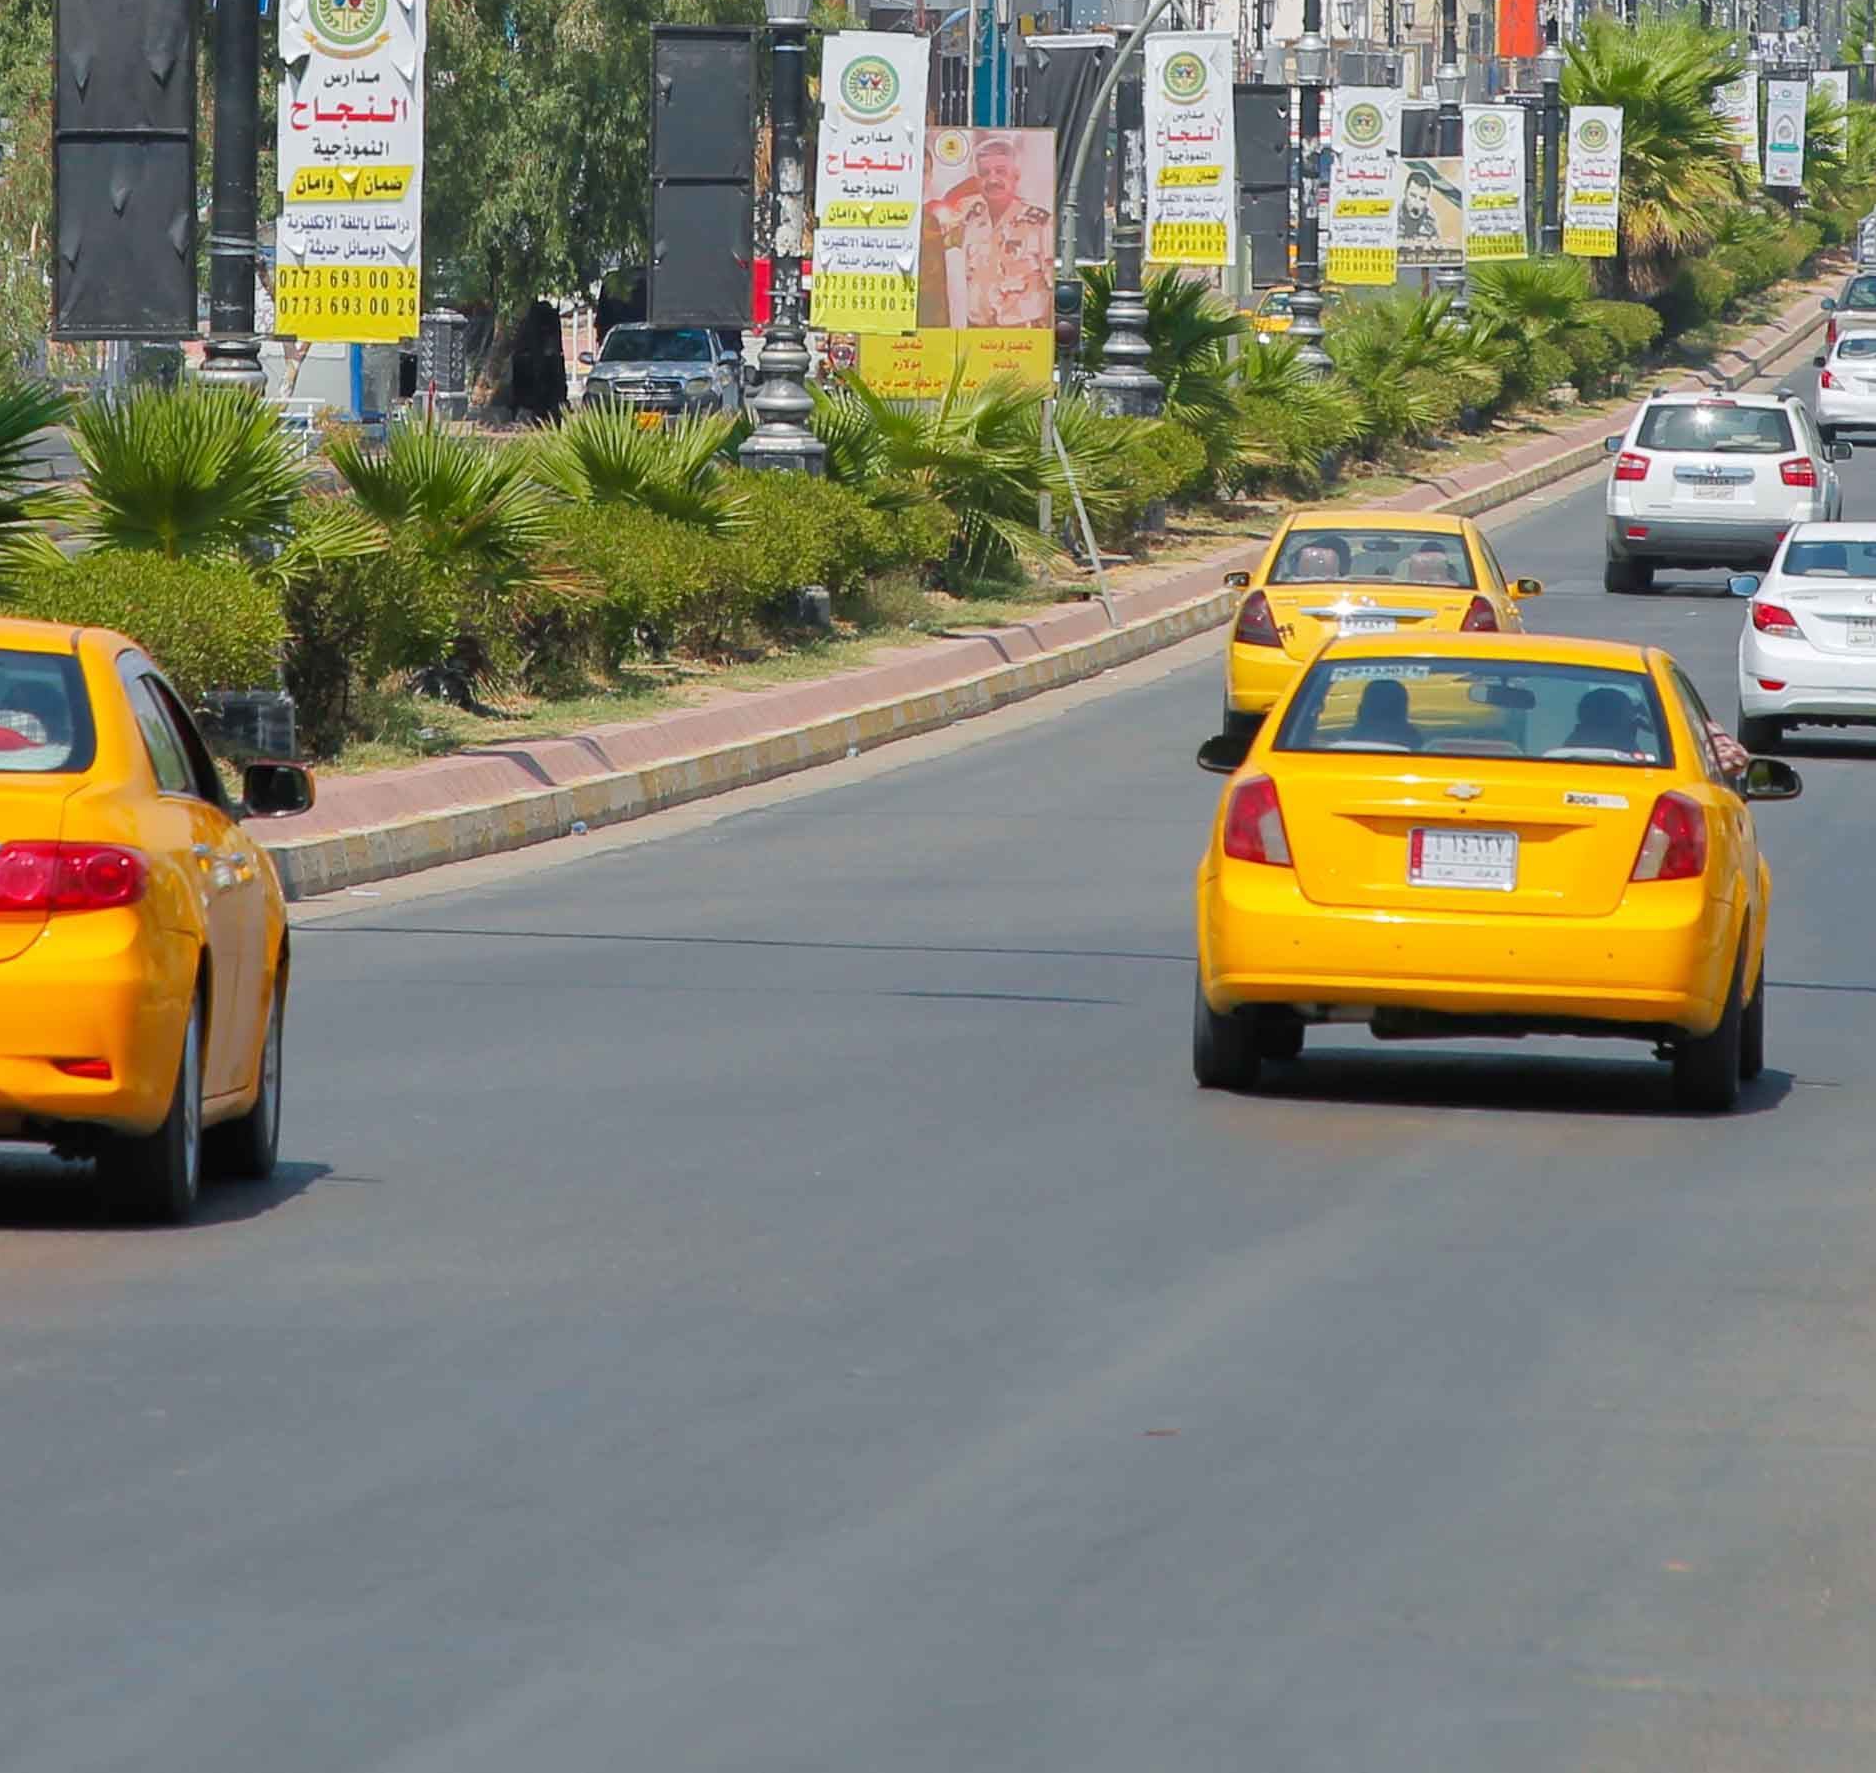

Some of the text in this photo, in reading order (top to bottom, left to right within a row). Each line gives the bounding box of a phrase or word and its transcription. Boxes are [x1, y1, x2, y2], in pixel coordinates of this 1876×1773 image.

[324, 71, 380, 88] مدارس
[290, 97, 408, 130] النجاح
[851, 131, 893, 144] مدارس
[314, 139, 389, 165] النموذجية
[827, 154, 912, 177] النجاح
[363, 177, 403, 196] ضمان
[842, 182, 899, 196] النموذجية
[340, 215, 371, 232] باللغة
[878, 208, 908, 222] ضمان
[309, 241, 340, 259] حديثة
[280, 271, 416, 290] 0773 693 00 32
[815, 276, 846, 290] 0773
[852, 276, 877, 291] 693
[881, 276, 896, 291] 00
[280, 298, 416, 316] 0773 693 00 29
[815, 295, 916, 310] 0773 693 00 29
